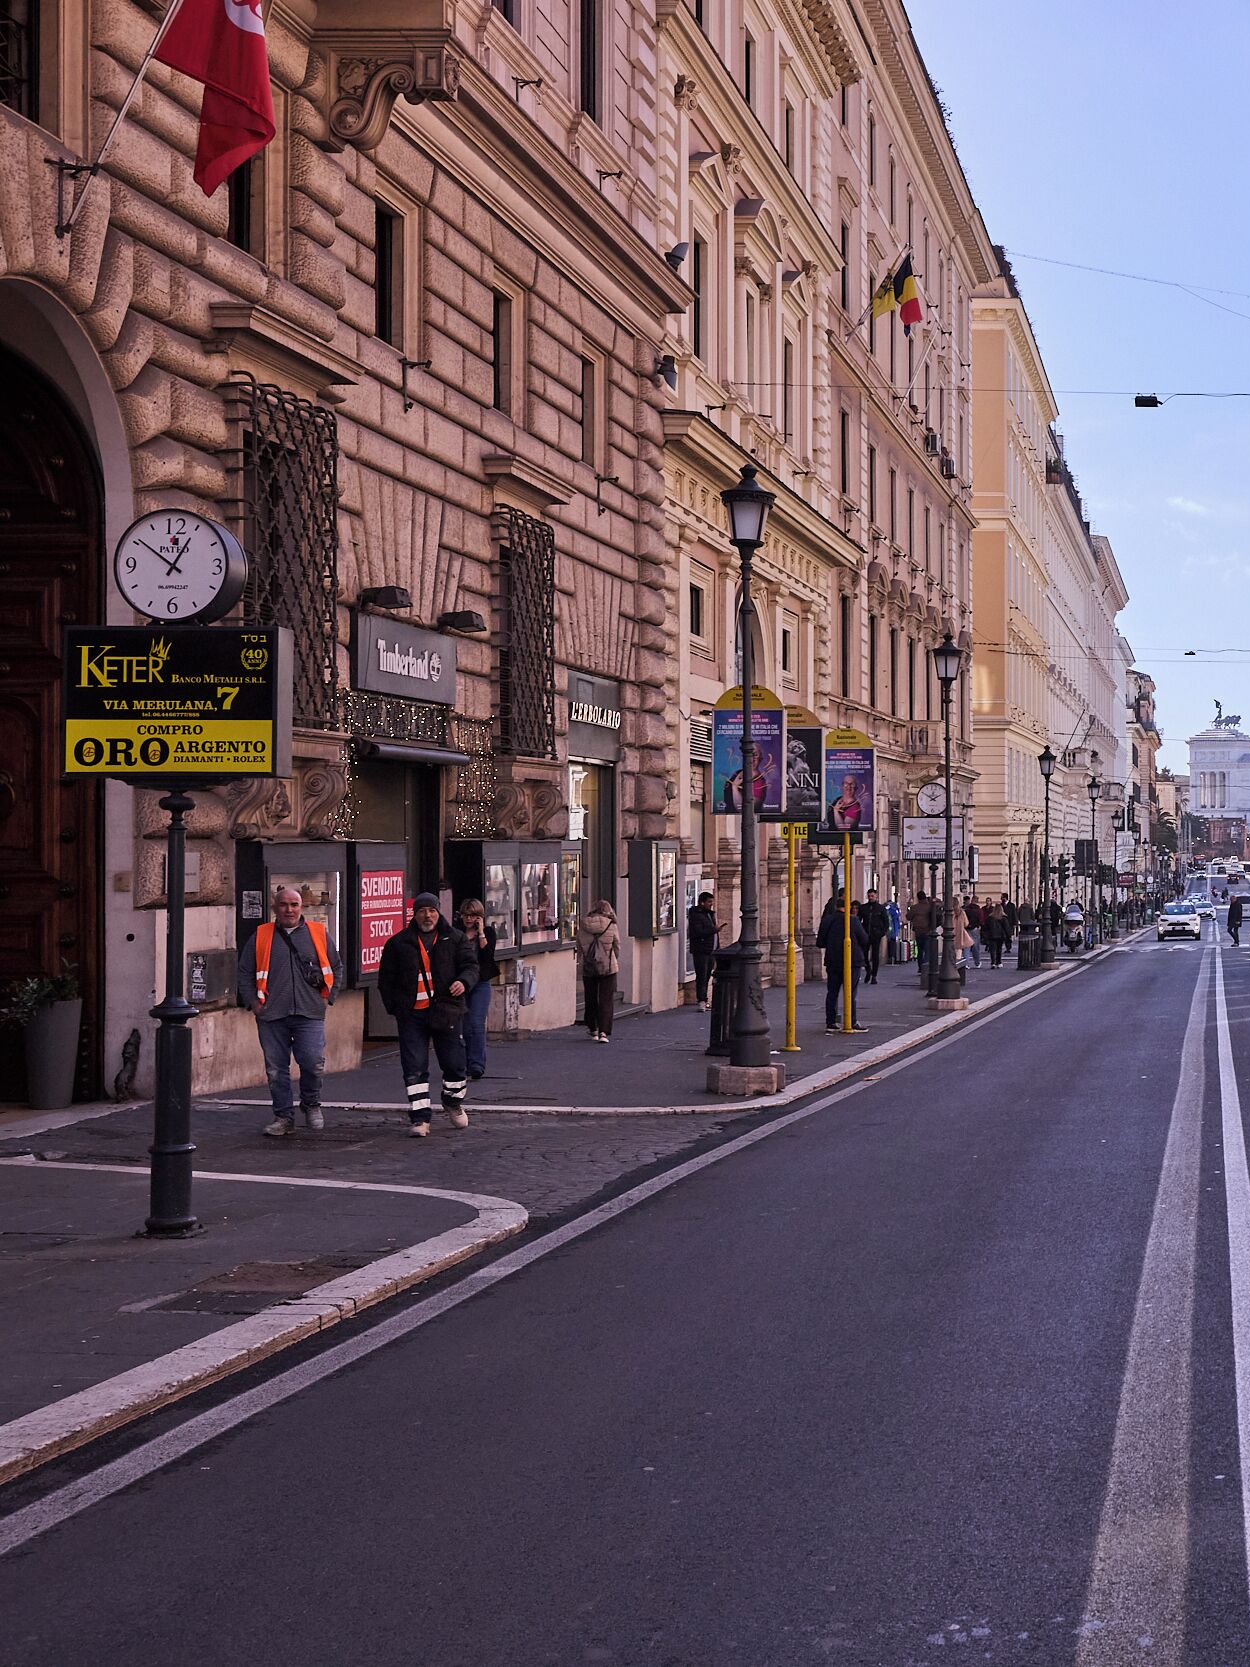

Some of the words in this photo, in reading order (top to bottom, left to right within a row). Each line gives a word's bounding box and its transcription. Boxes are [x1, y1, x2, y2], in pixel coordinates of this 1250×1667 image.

[165, 518, 187, 535] 12
[125, 556, 137, 575] 9
[211, 558, 223, 576] 3
[166, 596, 179, 614] 6
[245, 649, 263, 659] 40
[377, 637, 430, 680] Timberland
[75, 645, 165, 688] KETER
[171, 674, 202, 684] BANCO
[203, 674, 243, 684] METALLI
[103, 700, 129, 711] VIA
[132, 700, 218, 712] MERULANA,
[217, 686, 240, 710] 7
[570, 701, 622, 730] L'ERBOLARIO
[136, 724, 204, 736] COMPRO
[73, 737, 170, 767] ORO
[173, 740, 266, 753] ARGENTO
[173, 755, 224, 763] DIAMANTI
[232, 755, 266, 763] ROLEX
[783, 826, 807, 836] OTLE
[361, 876, 403, 897] SVENDITA
[369, 919, 394, 938] STOCK
